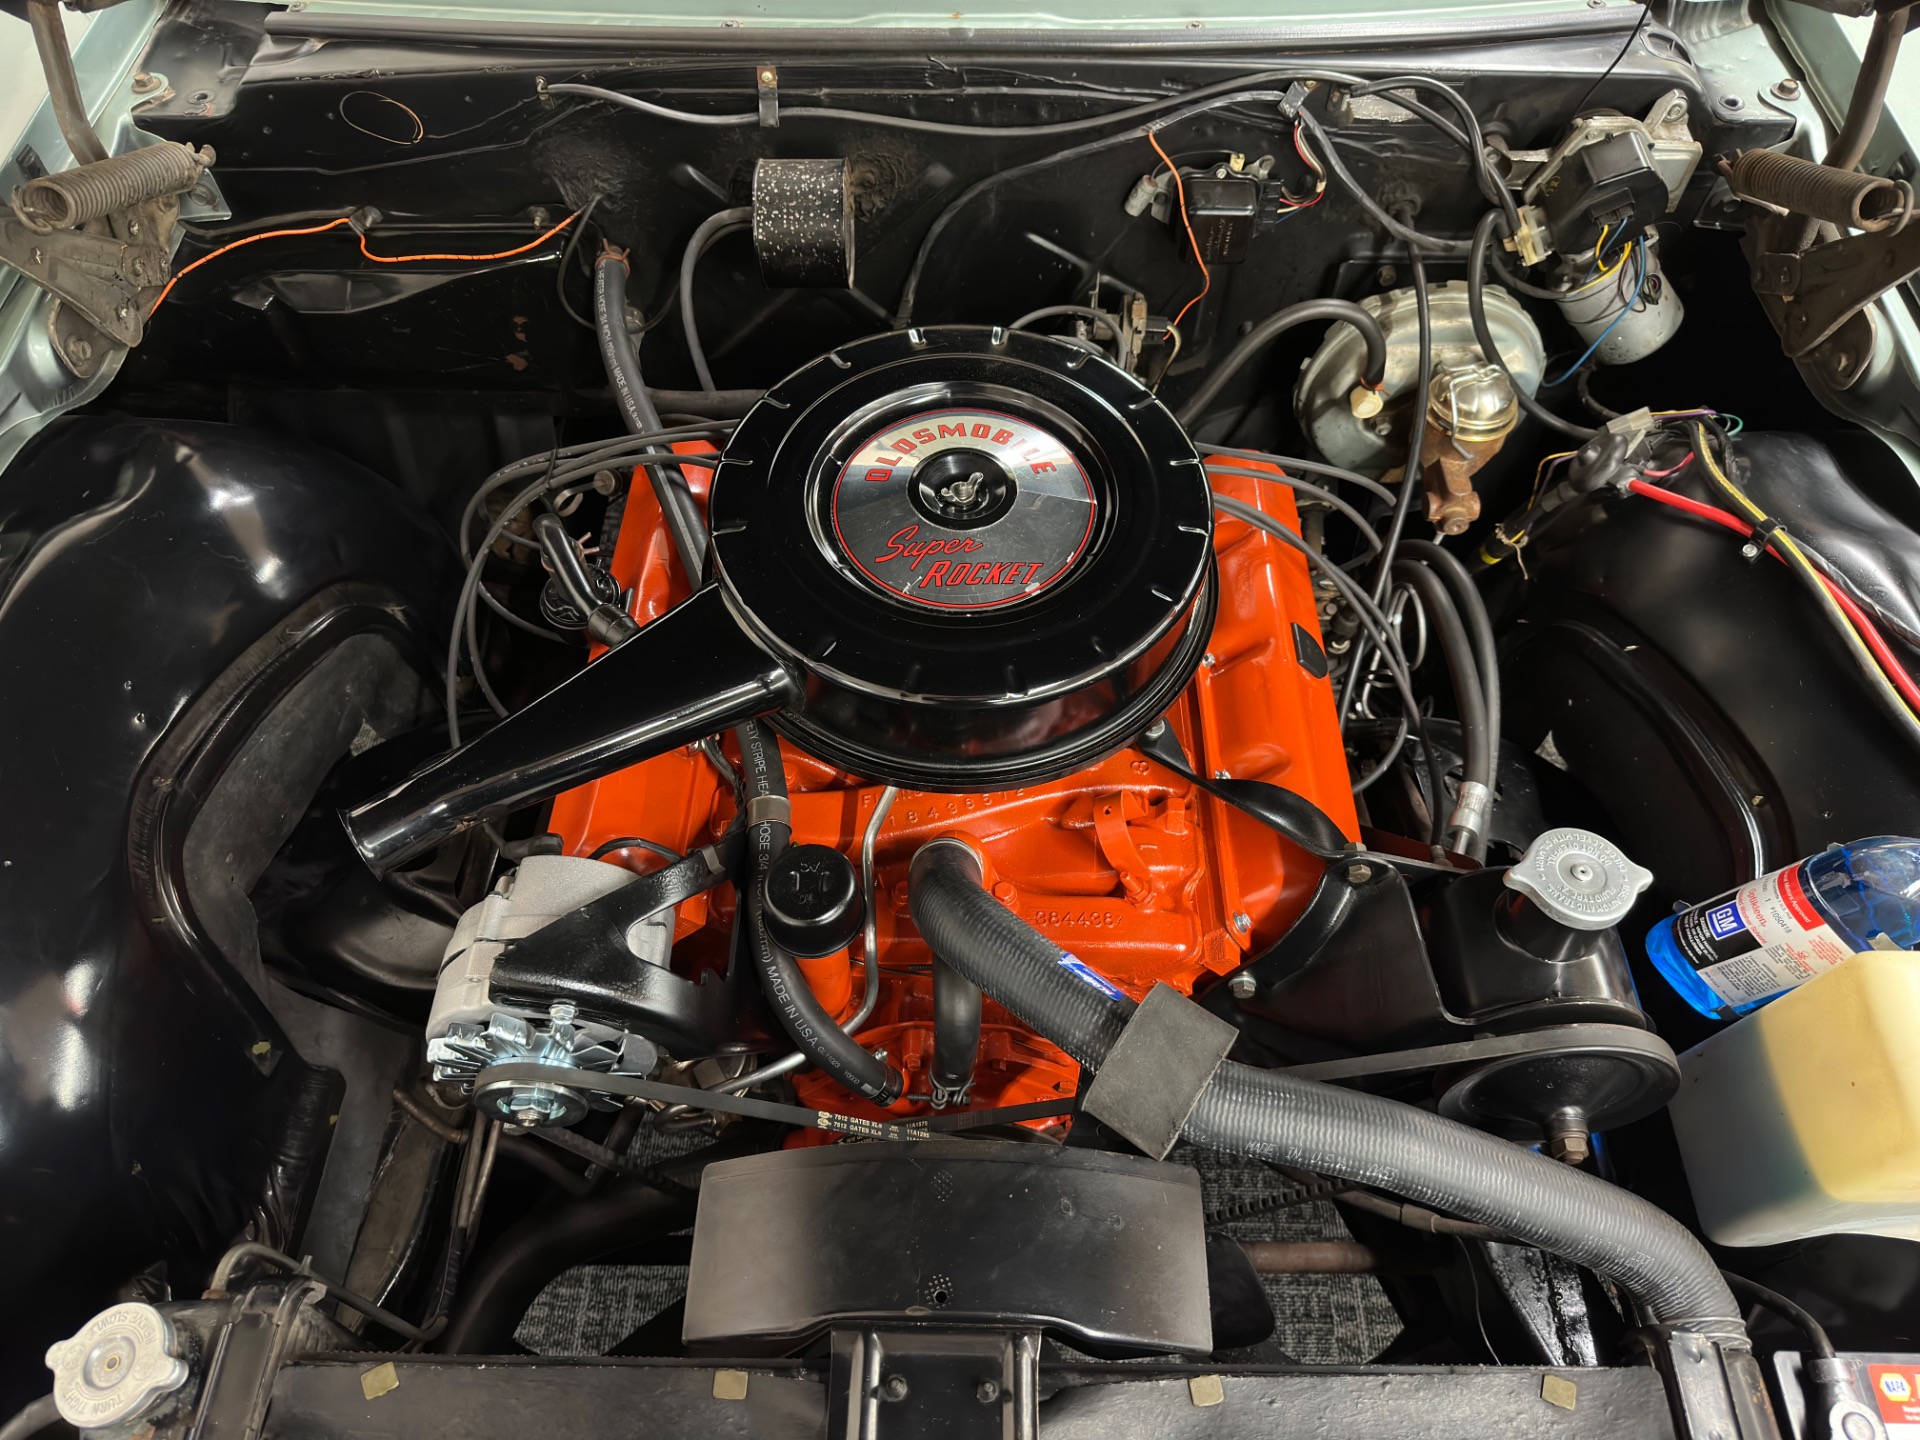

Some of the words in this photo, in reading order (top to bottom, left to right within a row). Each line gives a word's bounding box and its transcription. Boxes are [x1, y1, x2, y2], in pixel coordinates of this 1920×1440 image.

[613, 366, 627, 389] MADE
[620, 385, 630, 397] IN
[864, 422, 1057, 482] OLDSMOBILE
[874, 524, 983, 571] Super
[918, 559, 1044, 588] ROCKET
[750, 741, 767, 775] STRIPE
[759, 819, 772, 852] HOSE
[757, 852, 771, 871] 3/4
[1547, 842, 1579, 866] OVERFILL
[1582, 844, 1602, 859] NOT
[1600, 854, 1612, 867] DO
[1571, 891, 1595, 903] TYPE
[1595, 887, 1617, 904] FLUID
[1619, 884, 1630, 900] USE
[1576, 898, 1623, 913] AUTOMATIC
[1792, 899, 1811, 924] Approved
[1716, 907, 1738, 932] GM
[766, 965, 791, 1004] MADE
[784, 1003, 800, 1020] IN
[849, 1124, 870, 1134] GATES
[850, 1117, 871, 1127] GATES
[1244, 1141, 1277, 1155] MADE
[1285, 1146, 1302, 1160] IN
[89, 1310, 130, 1338] SLOWLY
[130, 1311, 158, 1345] REMOVE
[62, 1389, 88, 1415] TIGHT
[91, 1393, 123, 1416] TURN
